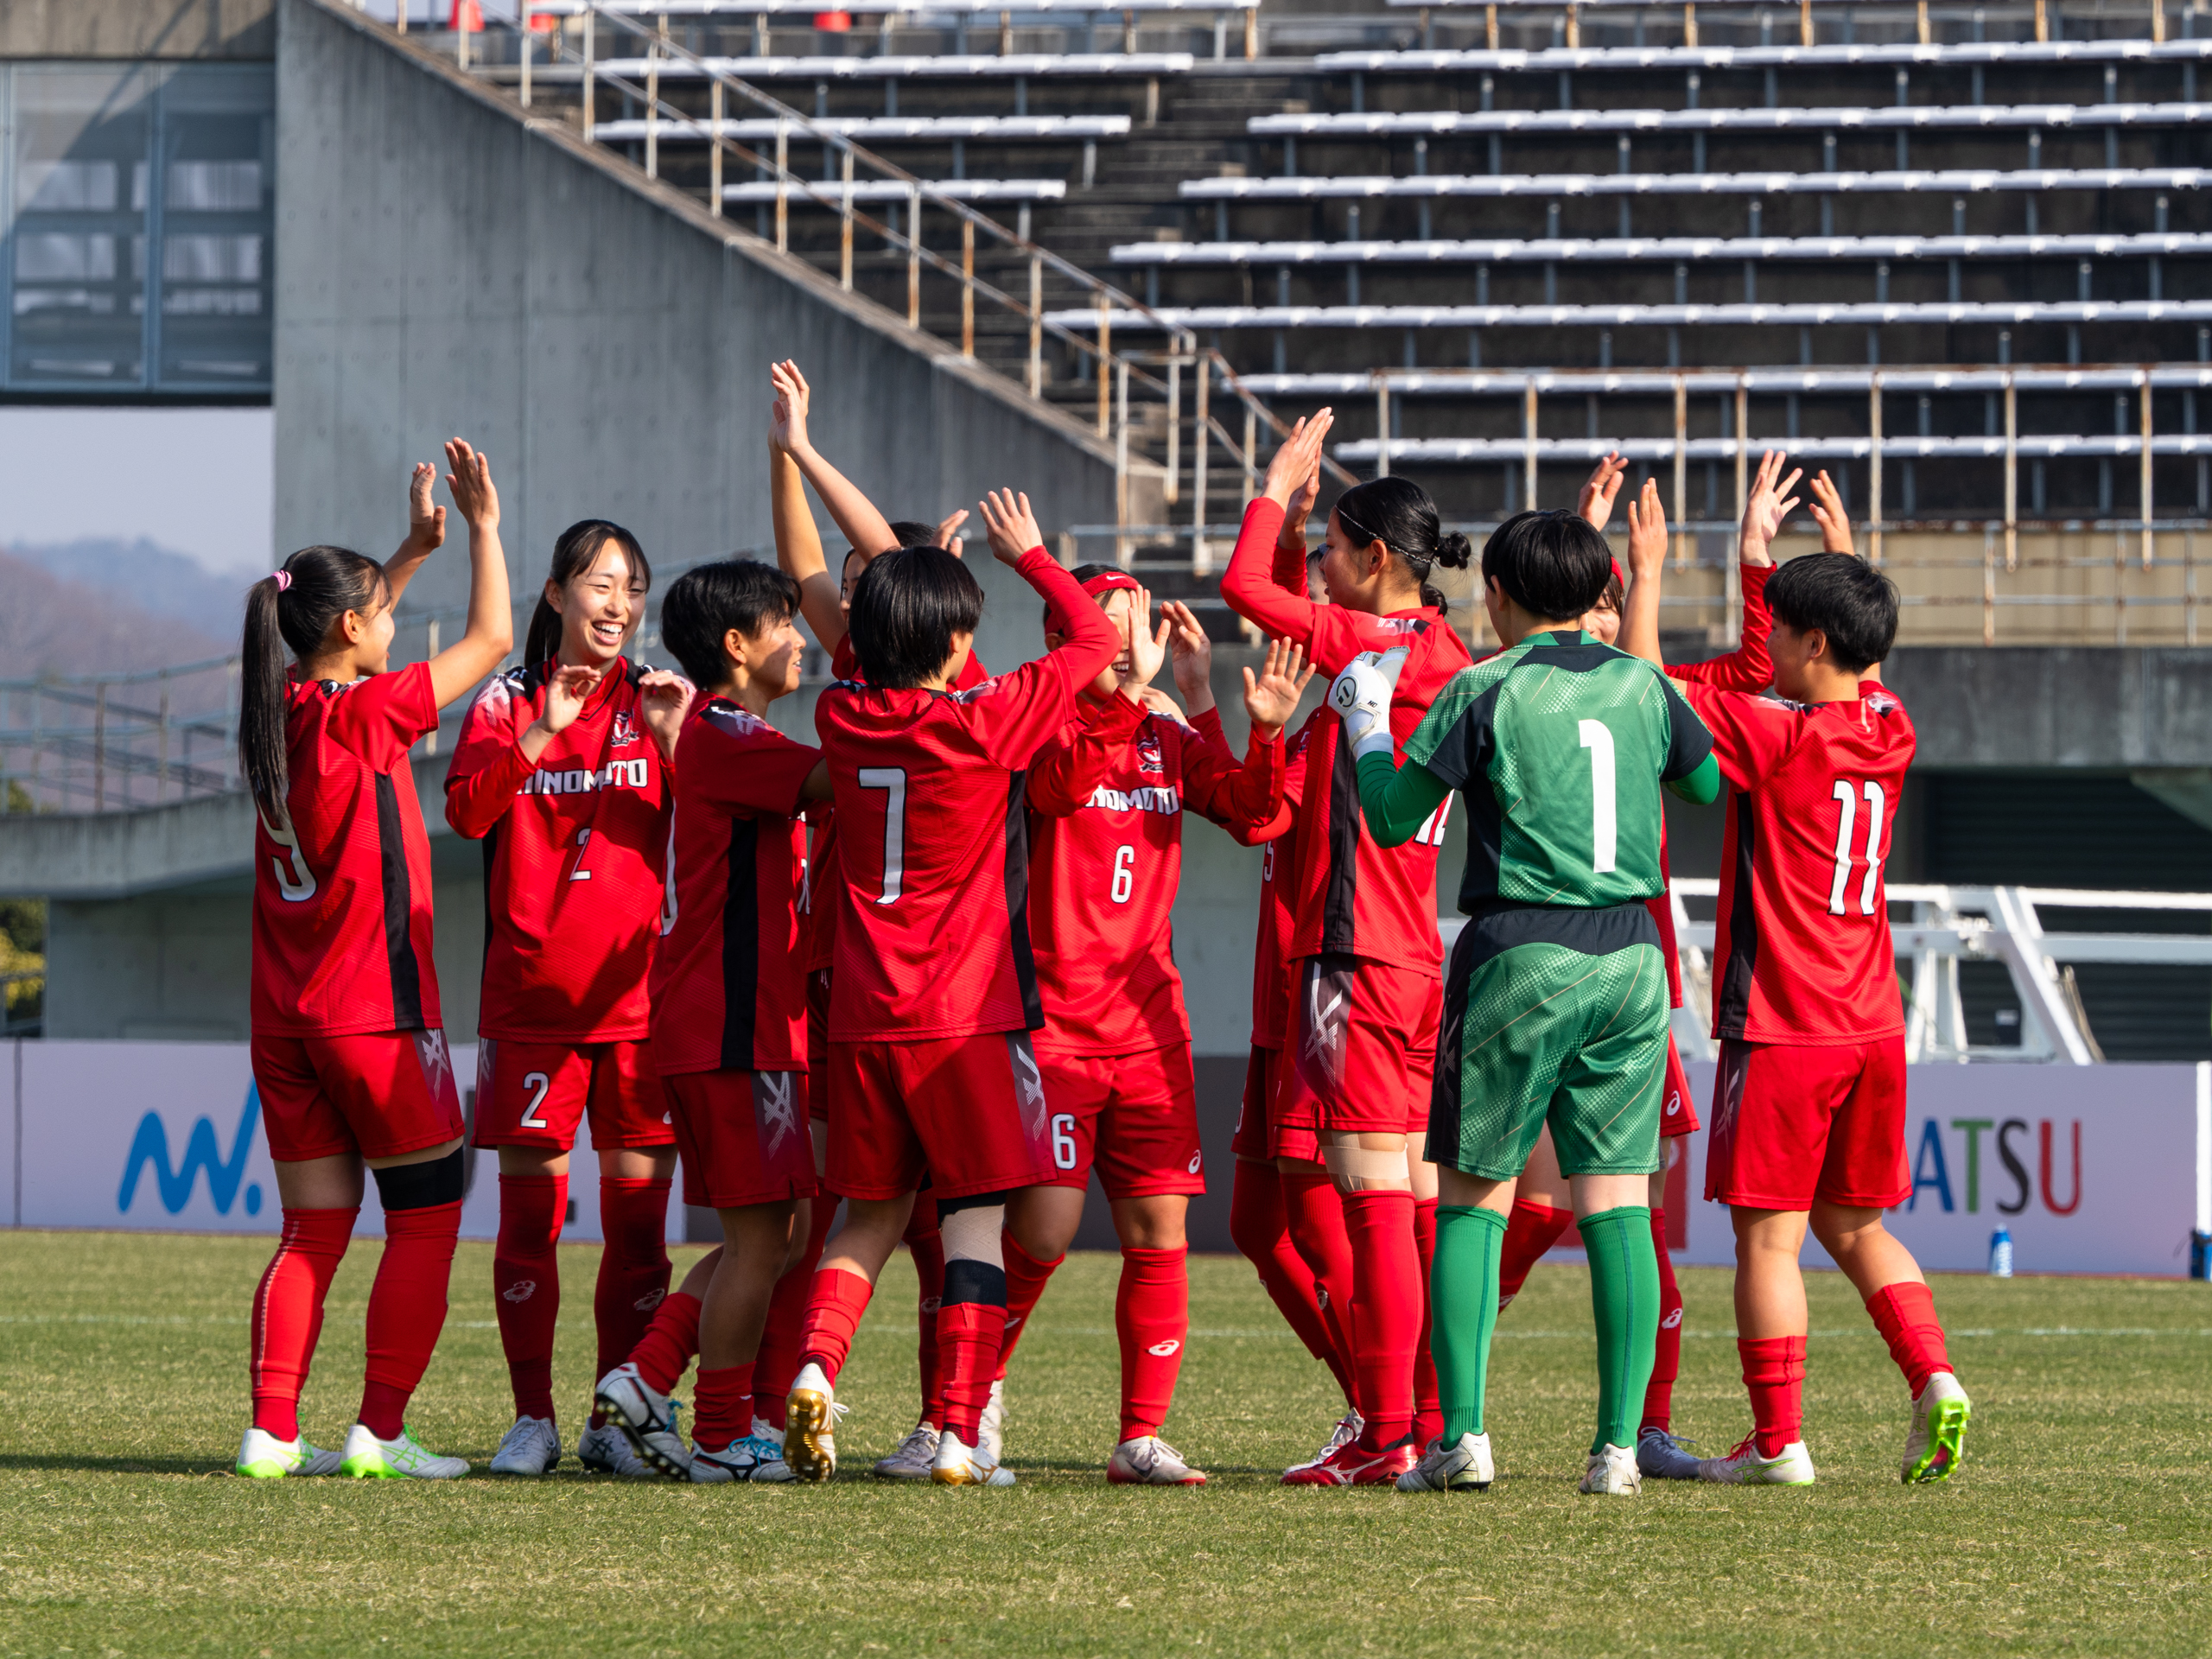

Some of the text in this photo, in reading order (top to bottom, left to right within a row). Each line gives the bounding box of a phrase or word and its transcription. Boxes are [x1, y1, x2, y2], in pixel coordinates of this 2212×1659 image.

[516, 758, 648, 796] INOMOTO
[1578, 718, 1618, 874] 1
[569, 826, 592, 882] 2
[857, 766, 906, 906] 7
[1827, 779, 1885, 917] 11
[1110, 844, 1135, 904] 6
[520, 1071, 550, 1129] 2
[1052, 1112, 1077, 1171] 6
[1906, 1117, 2083, 1217] ATSU
